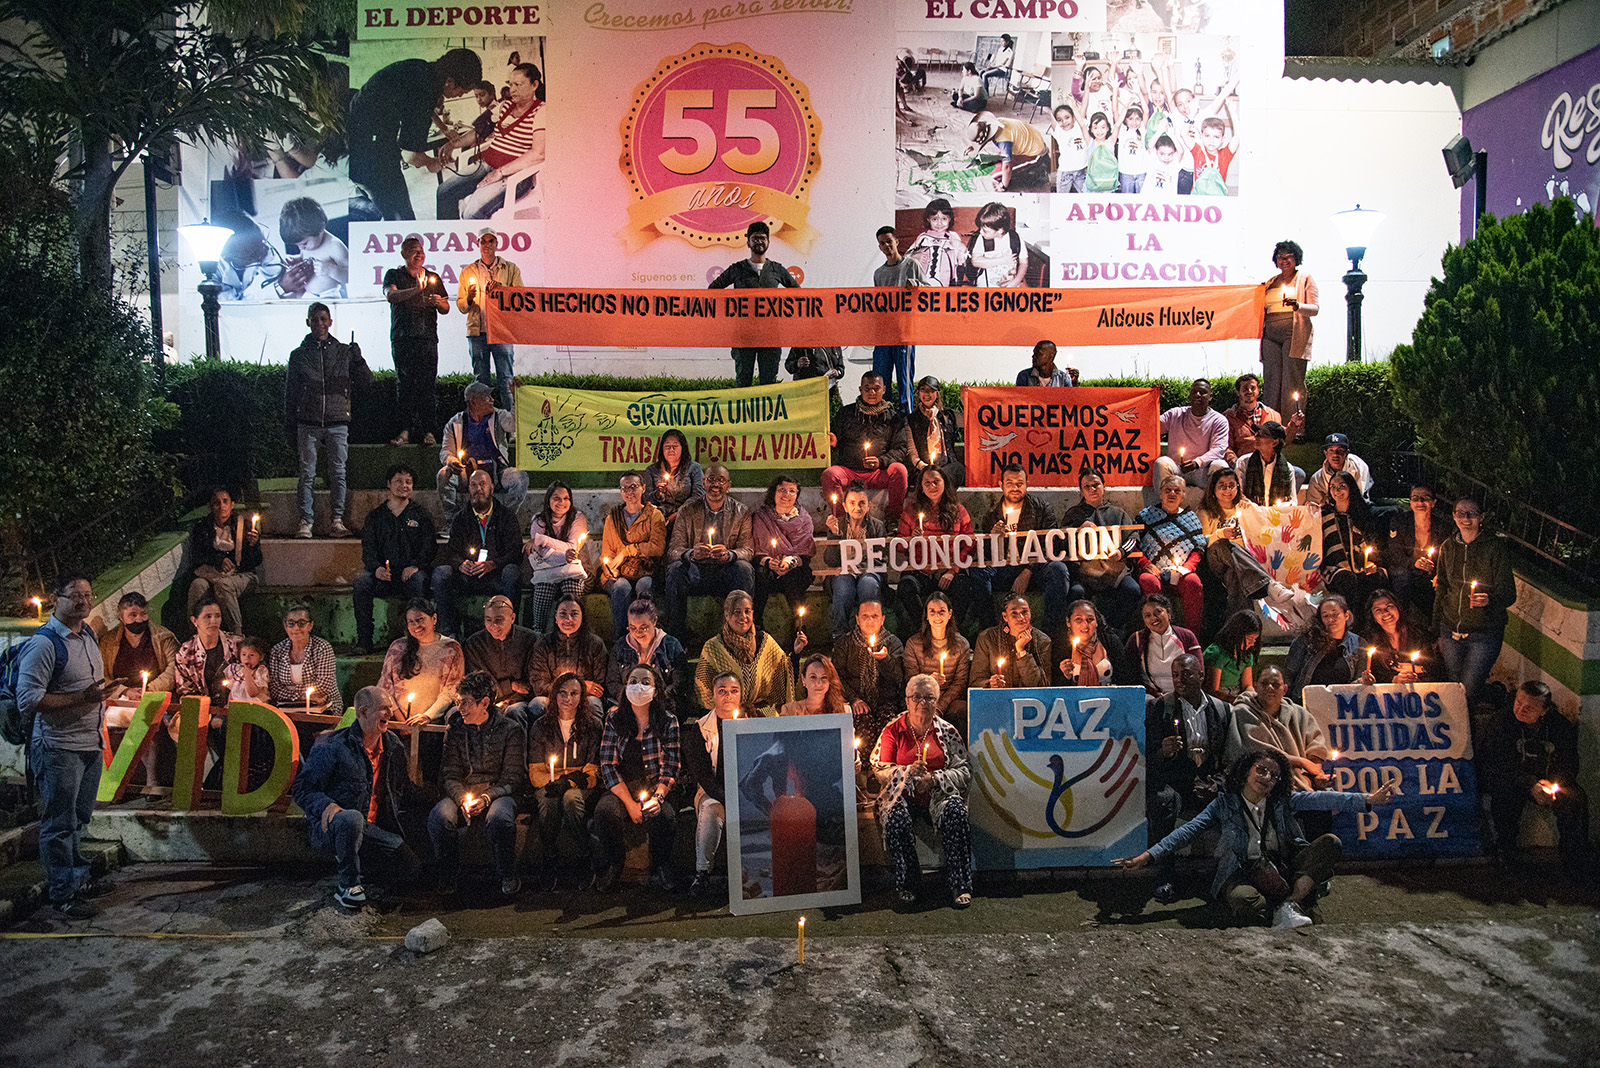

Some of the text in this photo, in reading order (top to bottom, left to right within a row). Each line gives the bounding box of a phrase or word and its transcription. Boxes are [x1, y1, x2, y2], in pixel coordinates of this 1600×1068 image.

[364, 5, 541, 28] EL DEPORTE
[583, 2, 696, 29] Crecemos
[702, 1, 764, 30] para
[925, 0, 1079, 19] EL CAMPO
[658, 89, 781, 175] 55
[688, 182, 756, 211] años
[1066, 203, 1223, 223] APOYANDO
[1126, 233, 1164, 251] LA
[631, 272, 696, 284] Síguenos en:
[1061, 259, 1228, 283] EDUCACIÓN
[539, 292, 617, 315] HECHOS
[620, 294, 650, 317] NO
[653, 295, 716, 319] DEJAN
[725, 296, 749, 318] DE
[754, 296, 824, 318] EXISTIR
[835, 291, 913, 313] PORQUE
[917, 291, 941, 312] SE
[945, 291, 980, 313] LES
[1096, 306, 1215, 330] Aldous Huxley
[626, 394, 789, 428] GRANADA UNIDA
[977, 404, 1109, 430] QUEREMOS
[695, 434, 737, 463] POR
[740, 434, 767, 462] LA
[1059, 429, 1141, 451] LA PAZ
[1028, 451, 1073, 475] MÁS
[1078, 452, 1150, 475] ARMAS
[839, 524, 1121, 575] RECONCILIACION
[1012, 697, 1111, 740] PAZ
[1334, 691, 1442, 720] MANOS
[1327, 722, 1452, 752] UNIDAS
[96, 691, 357, 815] VID
[1333, 763, 1464, 796] POR LA
[1357, 806, 1449, 841] PAZ
